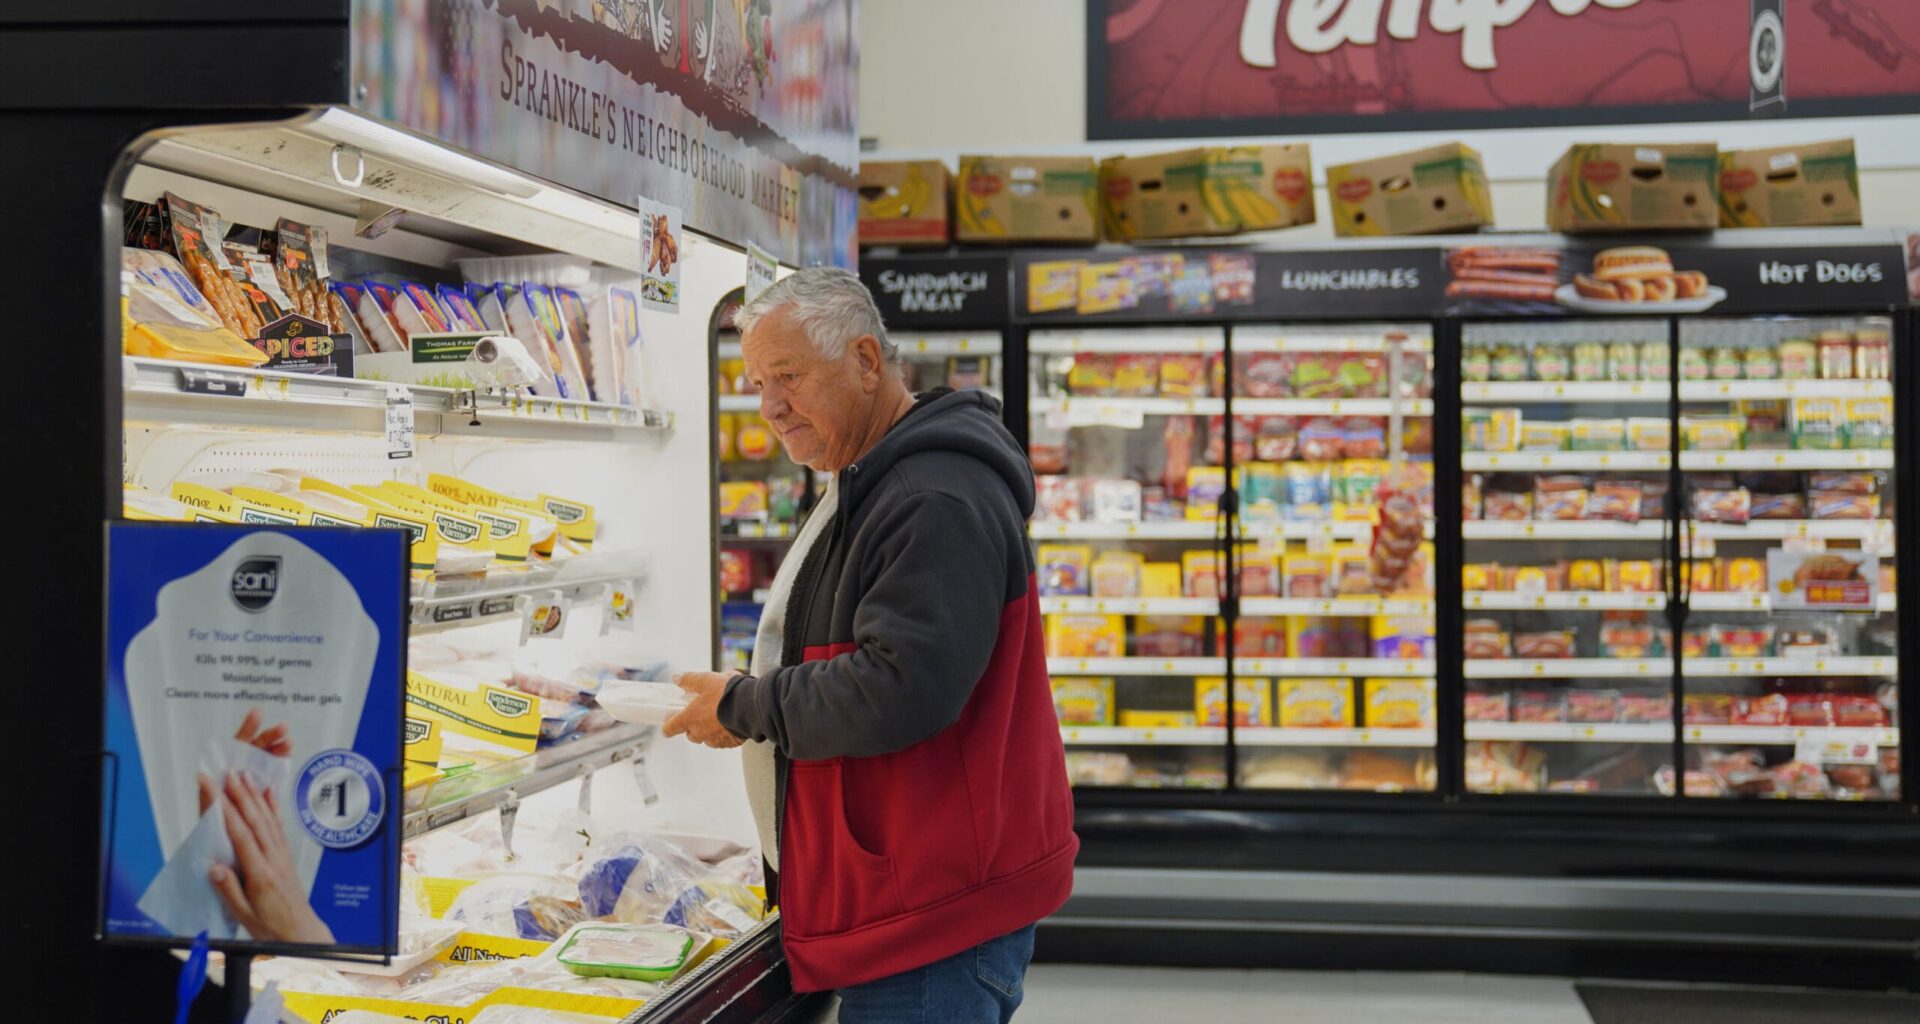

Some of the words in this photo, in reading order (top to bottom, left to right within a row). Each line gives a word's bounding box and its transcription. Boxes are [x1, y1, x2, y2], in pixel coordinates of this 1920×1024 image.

[501, 38, 617, 145] SPRANKLE'S
[622, 106, 747, 199] NEIGHBORHOOD
[751, 169, 798, 224] MARKET
[878, 269, 988, 293] SANDWICH
[1281, 267, 1420, 290] LUNCHABLES
[1759, 260, 1809, 285] HOT
[1815, 259, 1884, 283] DOGS
[900, 289, 967, 312] MEAT
[254, 335, 335, 359] SPICED
[426, 340, 457, 348] THOMAS
[437, 517, 476, 535] Sanderson
[443, 528, 467, 540] Farms
[233, 570, 275, 590] sani
[188, 628, 210, 641] For
[213, 629, 240, 642] Your
[243, 630, 325, 645] Convenience
[195, 654, 216, 665] Kills
[264, 656, 276, 667] of
[278, 659, 313, 670] germs
[222, 672, 284, 684] Moisturizes
[165, 687, 200, 699] Cleans
[203, 689, 229, 700] more
[233, 689, 289, 704] effectively
[292, 691, 316, 703] than
[320, 693, 343, 705] gels
[405, 678, 470, 706] NATURAL
[489, 692, 527, 710] Sanderson
[308, 754, 343, 778] HAND
[345, 755, 373, 778] WIPE
[319, 777, 349, 818] #1
[312, 809, 380, 844] HEALTHCARE
[449, 945, 471, 962] All
